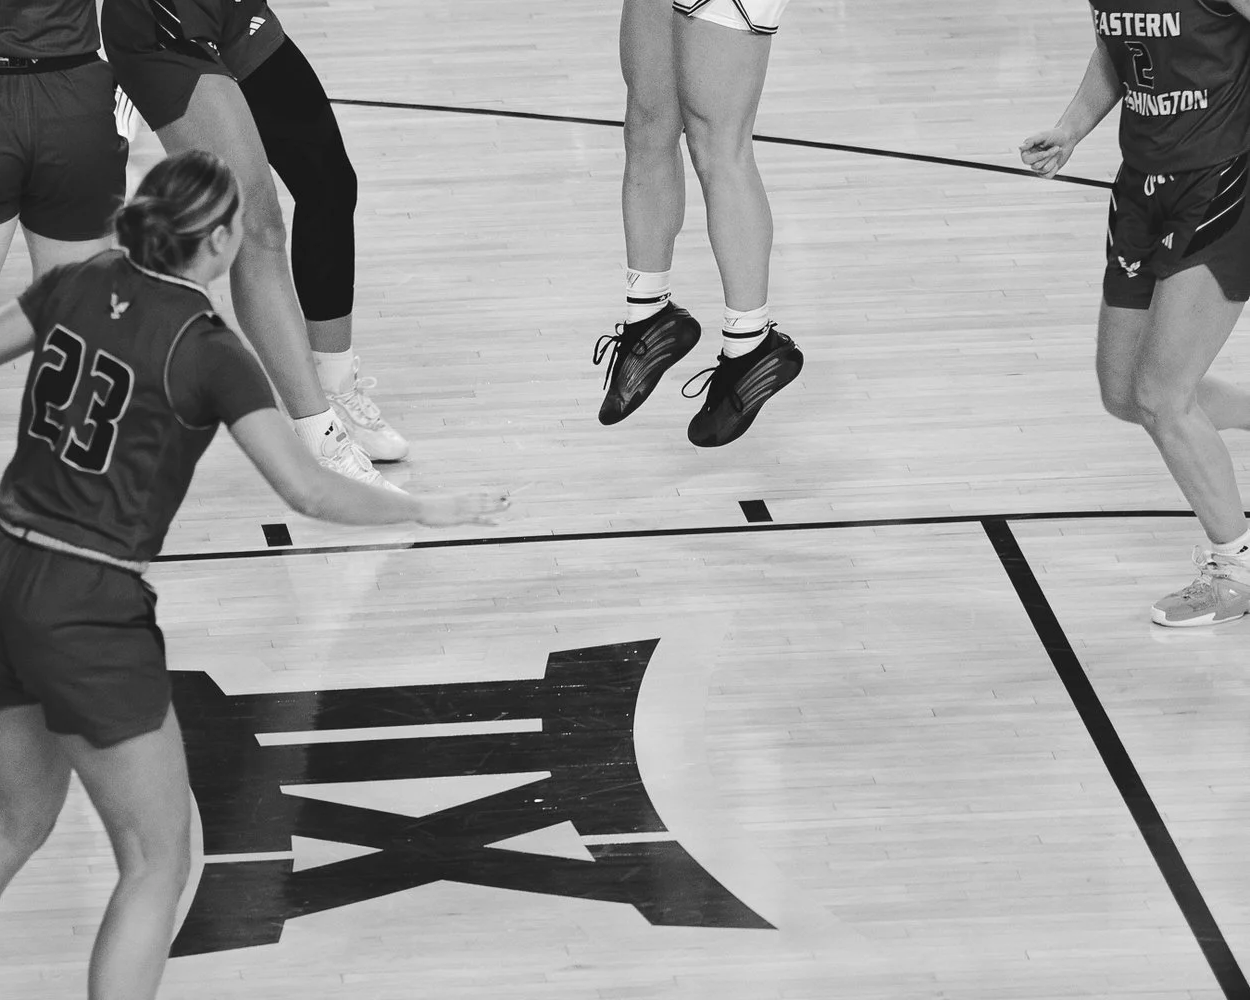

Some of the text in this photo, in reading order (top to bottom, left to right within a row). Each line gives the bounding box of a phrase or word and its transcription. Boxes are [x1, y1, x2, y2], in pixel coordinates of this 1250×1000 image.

[1124, 41, 1155, 89] 2
[1124, 87, 1209, 117] SHINGTON
[28, 323, 135, 475] 23
